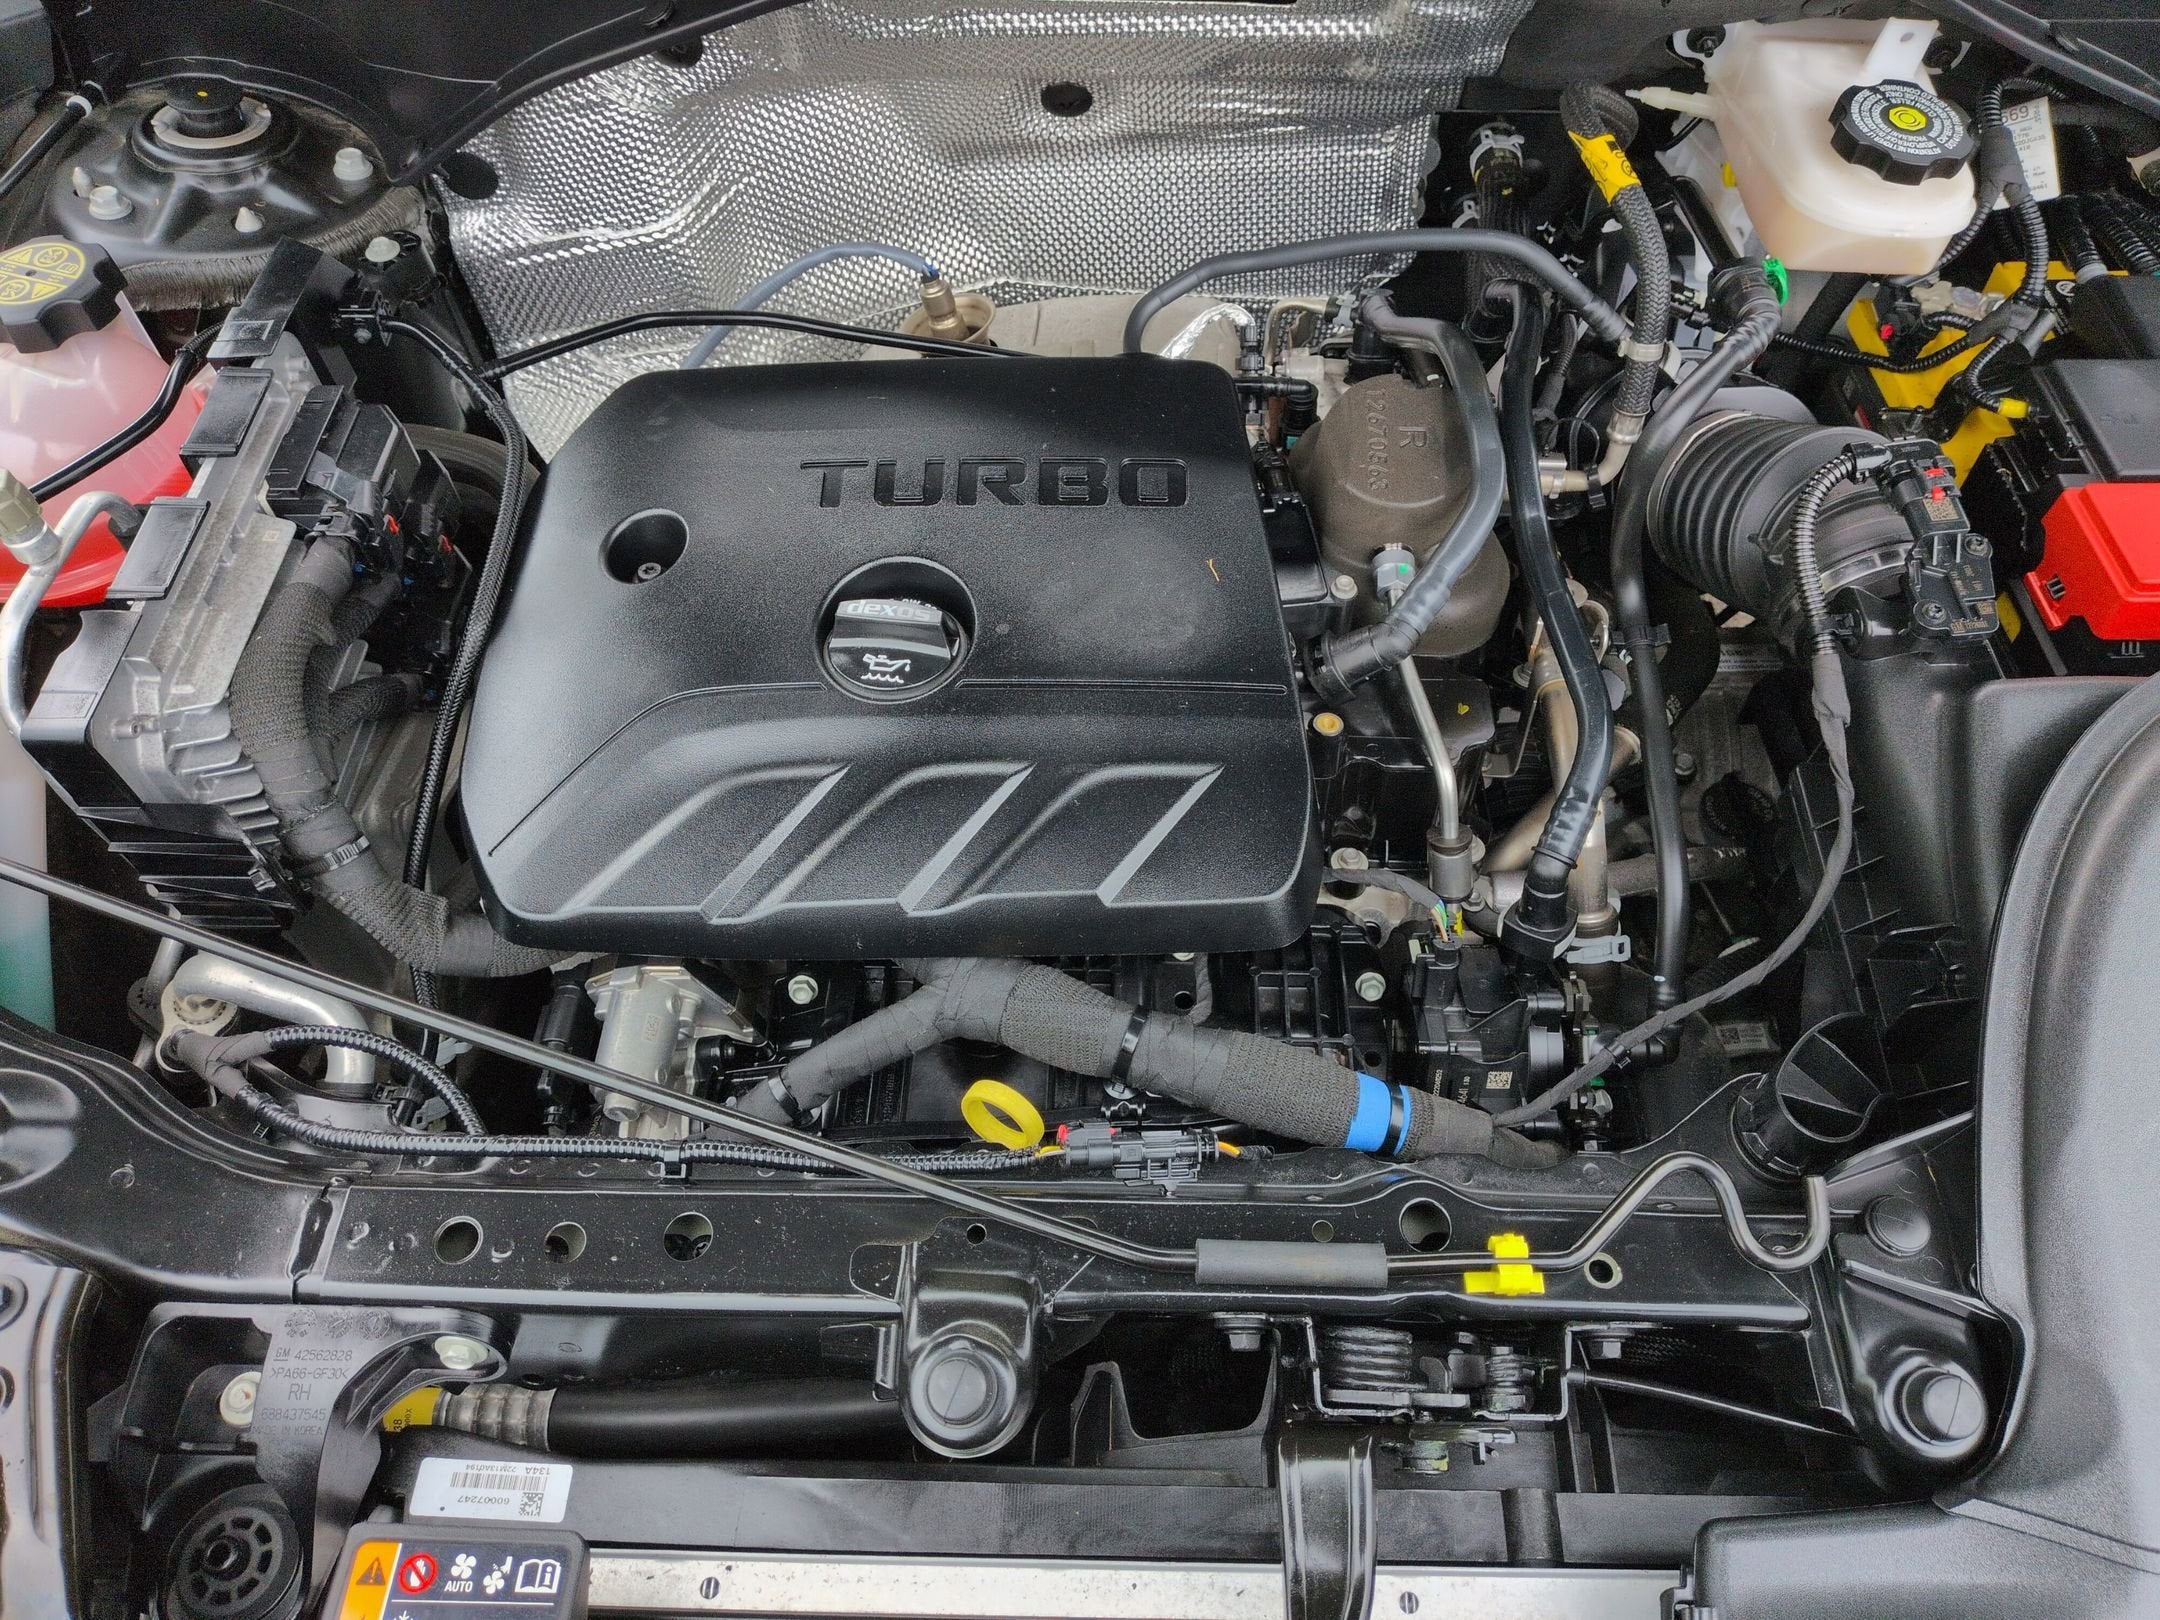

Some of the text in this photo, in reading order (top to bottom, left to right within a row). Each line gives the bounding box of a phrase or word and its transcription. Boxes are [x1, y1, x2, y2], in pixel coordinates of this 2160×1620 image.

[1399, 426, 1428, 449] R
[800, 457, 1190, 509] TURBO
[847, 599, 931, 621] dexos
[275, 1347, 353, 1362] GM 42562828
[288, 1383, 312, 1401] RH
[525, 1466, 551, 1476] 134A
[444, 1580, 473, 1593] AUTO
